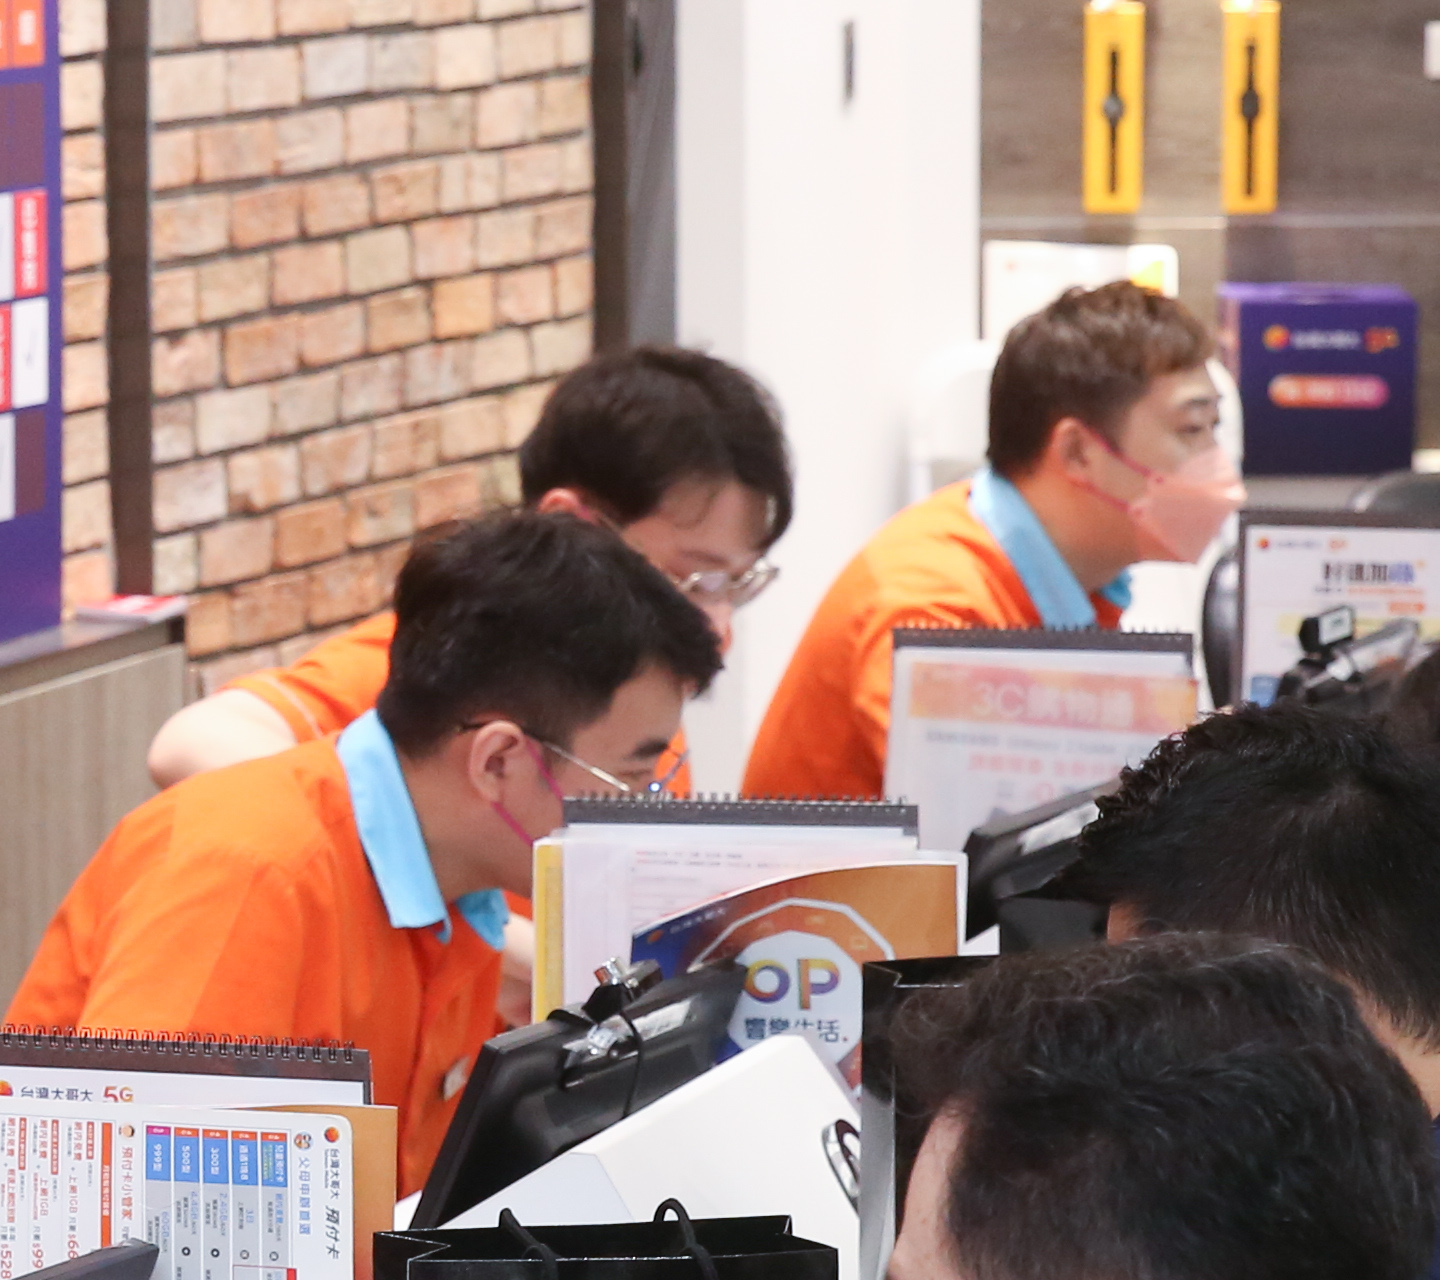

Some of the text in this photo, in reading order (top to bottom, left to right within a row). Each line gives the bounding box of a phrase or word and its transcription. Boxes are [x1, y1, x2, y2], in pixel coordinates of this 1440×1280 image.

[743, 958, 841, 1011] OP
[325, 1148, 340, 1259] 台灣大哥大 預付卡
[0, 1243, 12, 1279] $528
